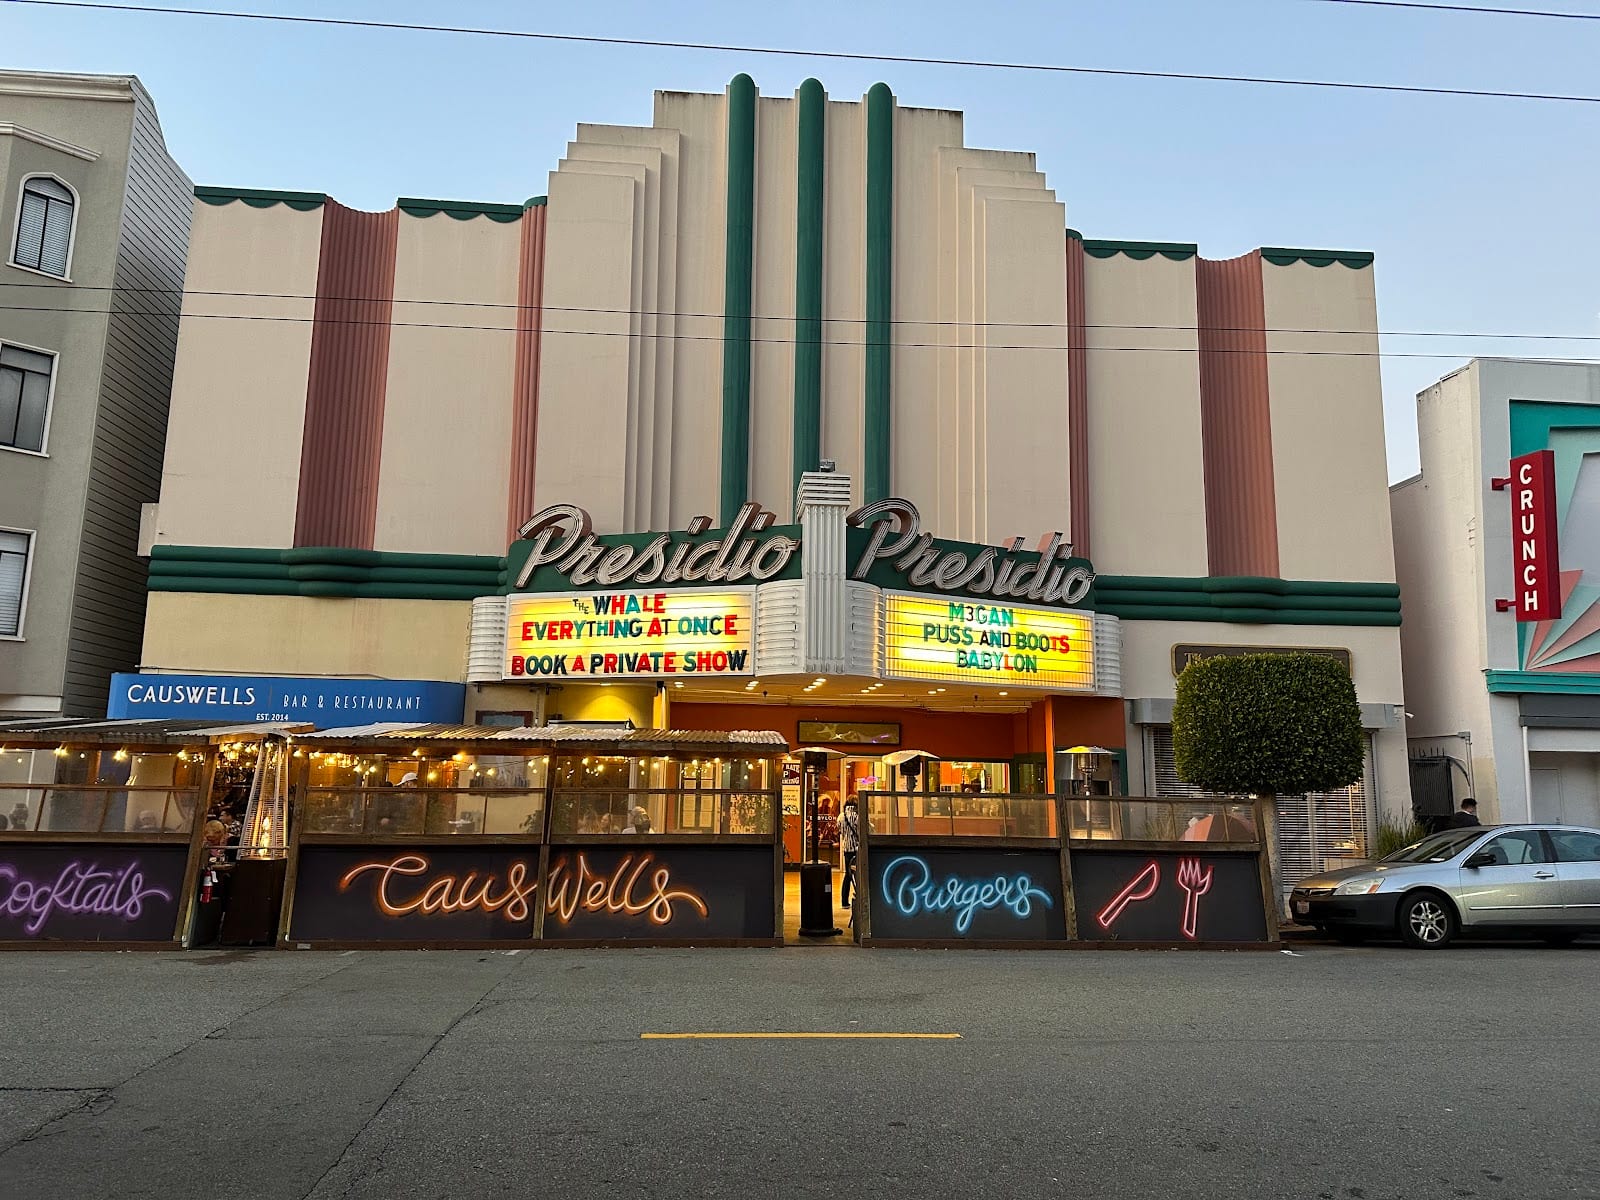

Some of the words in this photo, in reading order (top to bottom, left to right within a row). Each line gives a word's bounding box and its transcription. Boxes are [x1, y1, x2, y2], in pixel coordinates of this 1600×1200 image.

[512, 502, 800, 589] Presidio
[1519, 463, 1538, 611] CRUNCH
[846, 497, 1096, 605] Presidio
[572, 598, 590, 615] THE
[592, 593, 667, 616] WHALE
[948, 602, 1014, 627] M3GAN
[521, 617, 643, 641] EVERYTHING
[646, 617, 672, 637] AT
[677, 614, 738, 637] ONCE
[923, 622, 974, 646] PUSS
[979, 629, 1011, 649] AND
[1015, 631, 1071, 654] BOOTS
[511, 653, 568, 675] BOOK
[571, 654, 586, 672] A
[589, 651, 677, 674] PRIVATE
[682, 649, 748, 673] SHOW
[956, 648, 1038, 674] BABYLON
[126, 683, 256, 706] CAUSWELLS
[283, 694, 308, 708] BAR
[317, 695, 325, 709] &
[334, 694, 422, 710] RESTAURANT
[256, 713, 270, 721] EST.
[271, 713, 289, 722] 2014
[882, 855, 1053, 933] Burgers
